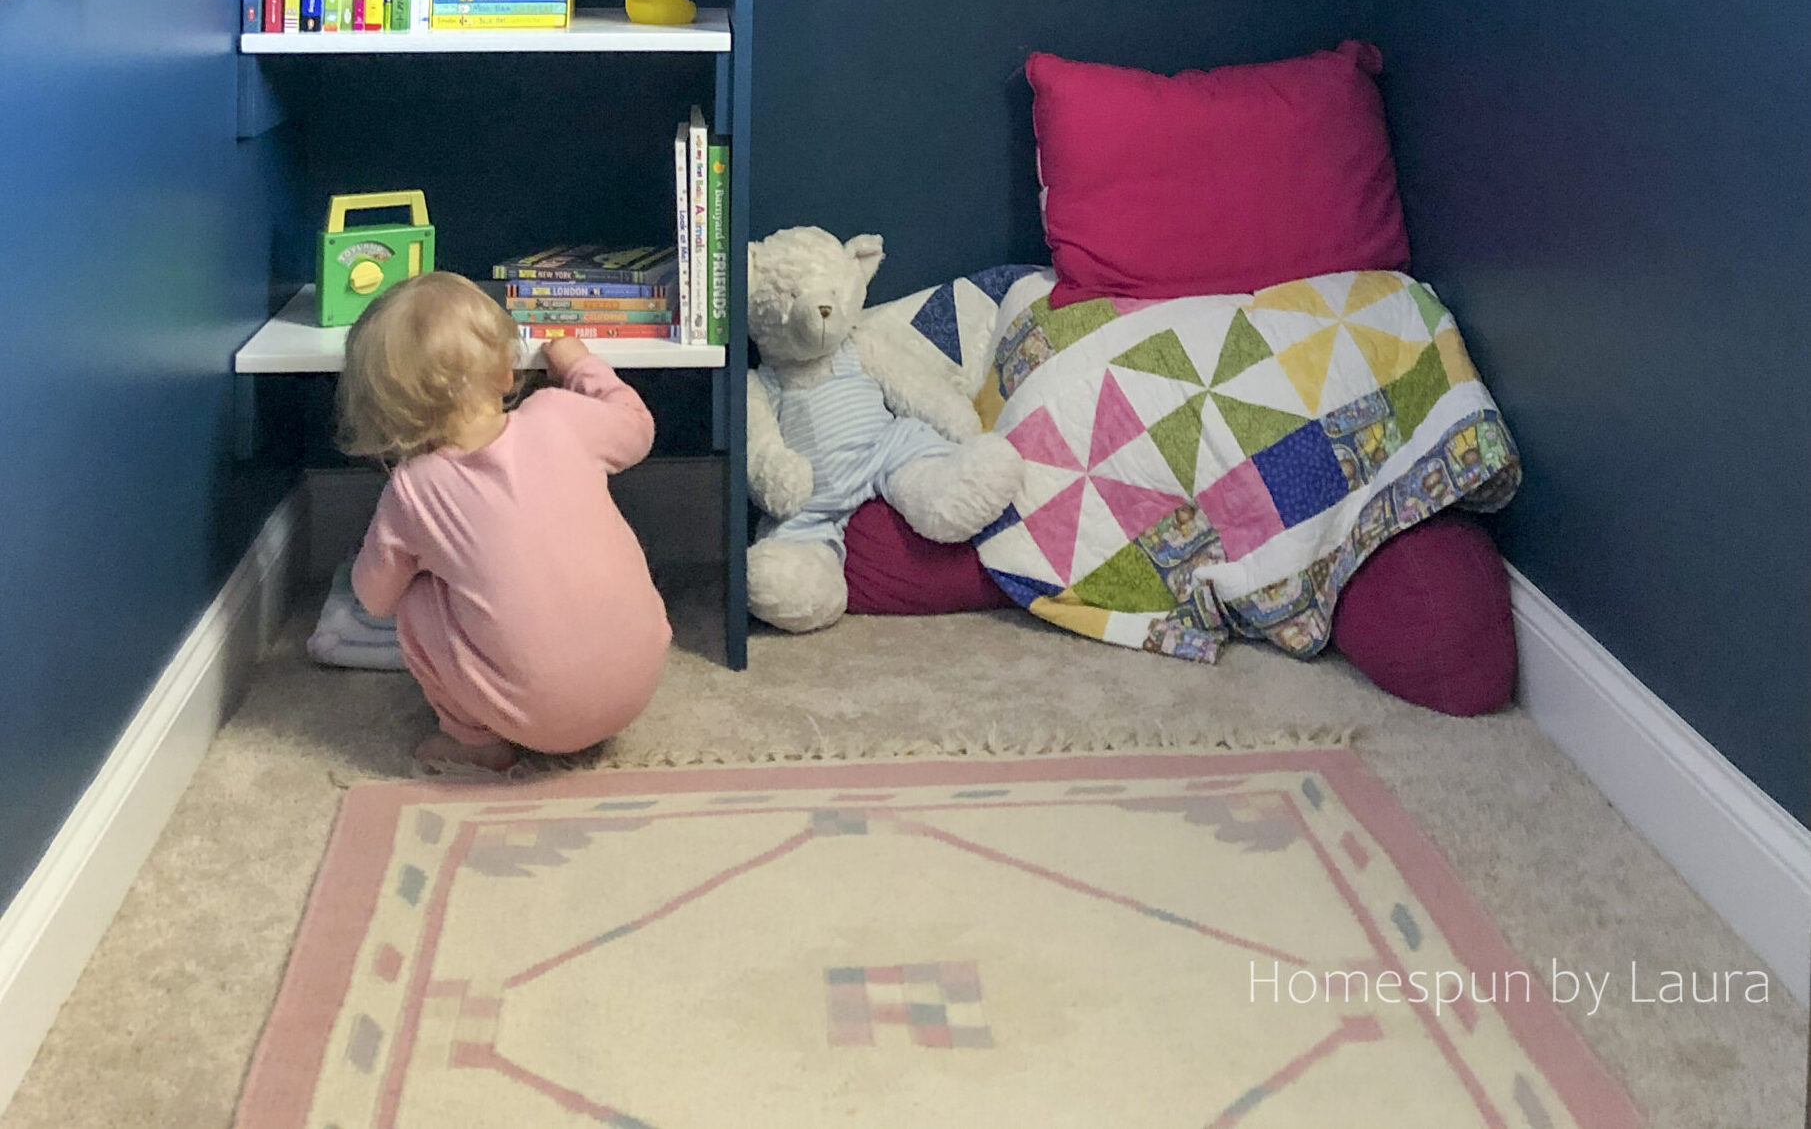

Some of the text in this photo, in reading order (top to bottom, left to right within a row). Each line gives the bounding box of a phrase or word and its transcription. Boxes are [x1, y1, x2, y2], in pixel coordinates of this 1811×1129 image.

[679, 211, 687, 230] Look
[712, 190, 725, 240] Barnyard
[695, 206, 706, 254] Animals
[680, 234, 687, 244] at
[538, 270, 553, 279] NEW
[554, 271, 572, 280] YORK
[552, 286, 588, 296] LONDON
[712, 252, 727, 320] FRIENDS
[575, 328, 598, 338] PARIS
